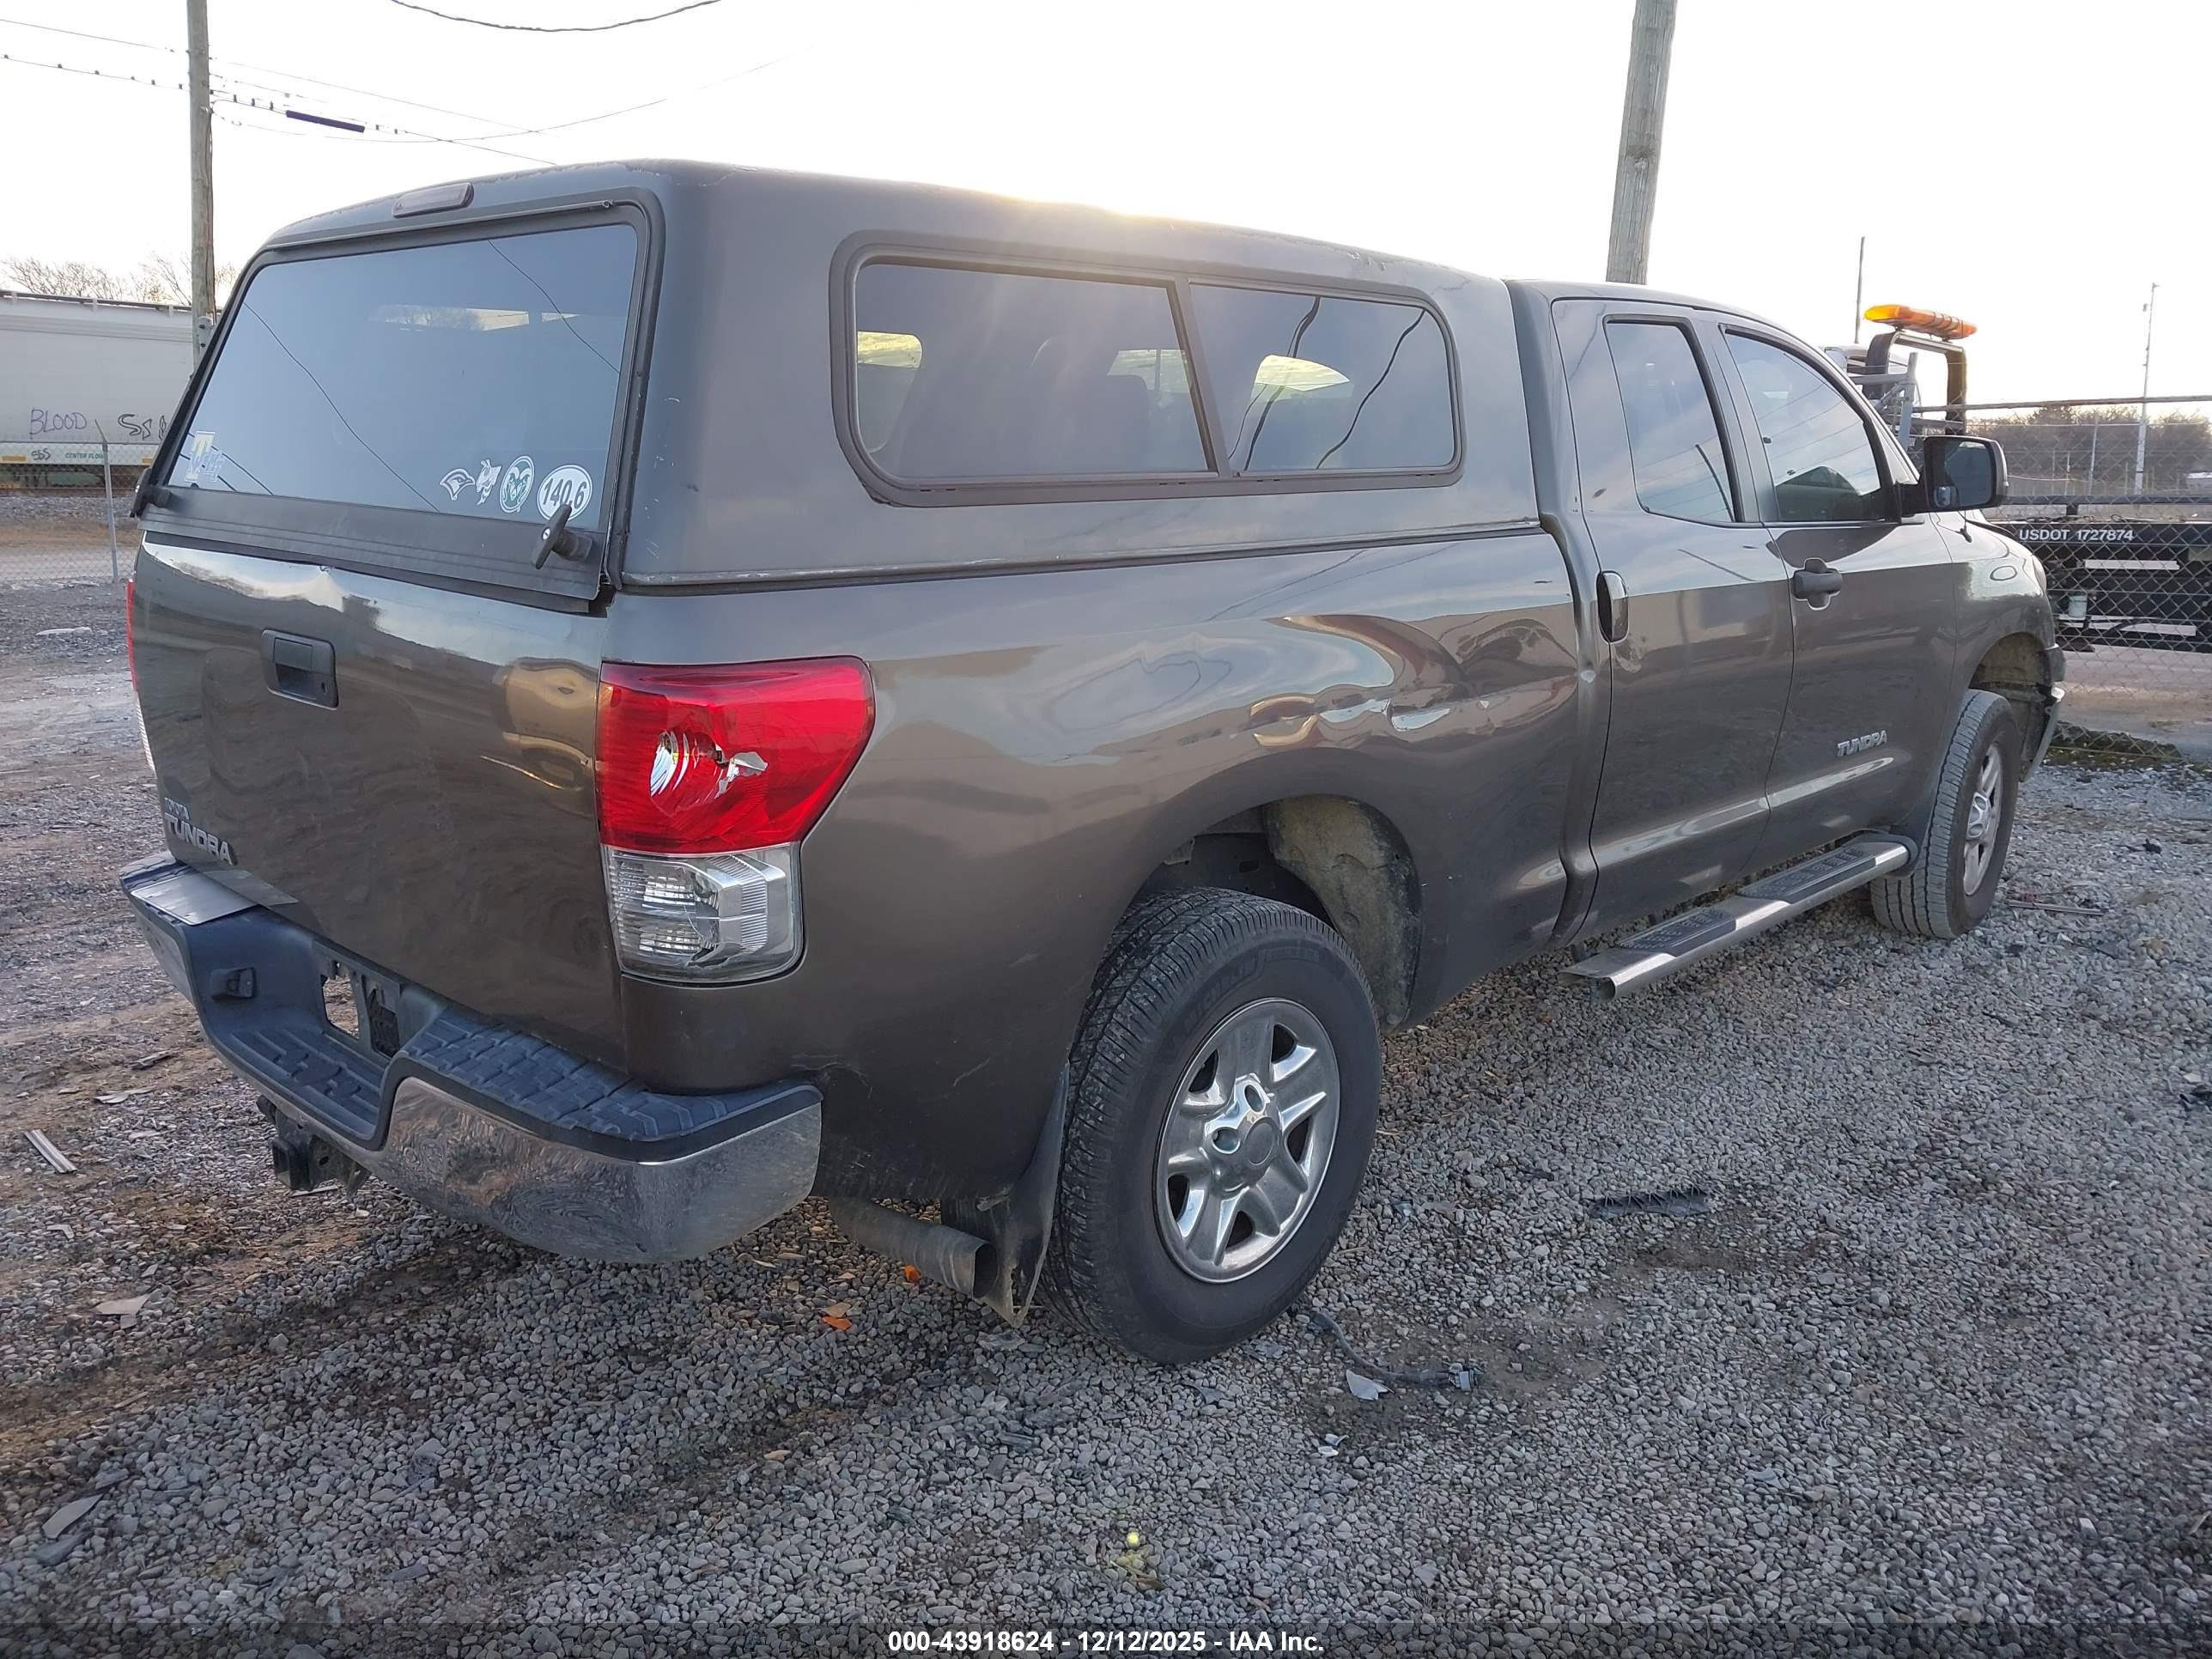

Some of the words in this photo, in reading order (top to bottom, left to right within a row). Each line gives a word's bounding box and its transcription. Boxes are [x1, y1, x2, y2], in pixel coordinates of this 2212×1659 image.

[29, 408, 87, 440] BLOOD
[543, 477, 587, 509] 140.6
[2019, 529, 2069, 541] USDOT
[2075, 529, 2135, 542] 1727874
[1837, 729, 1887, 757] TUNDRA
[164, 811, 234, 866] TUNDRA
